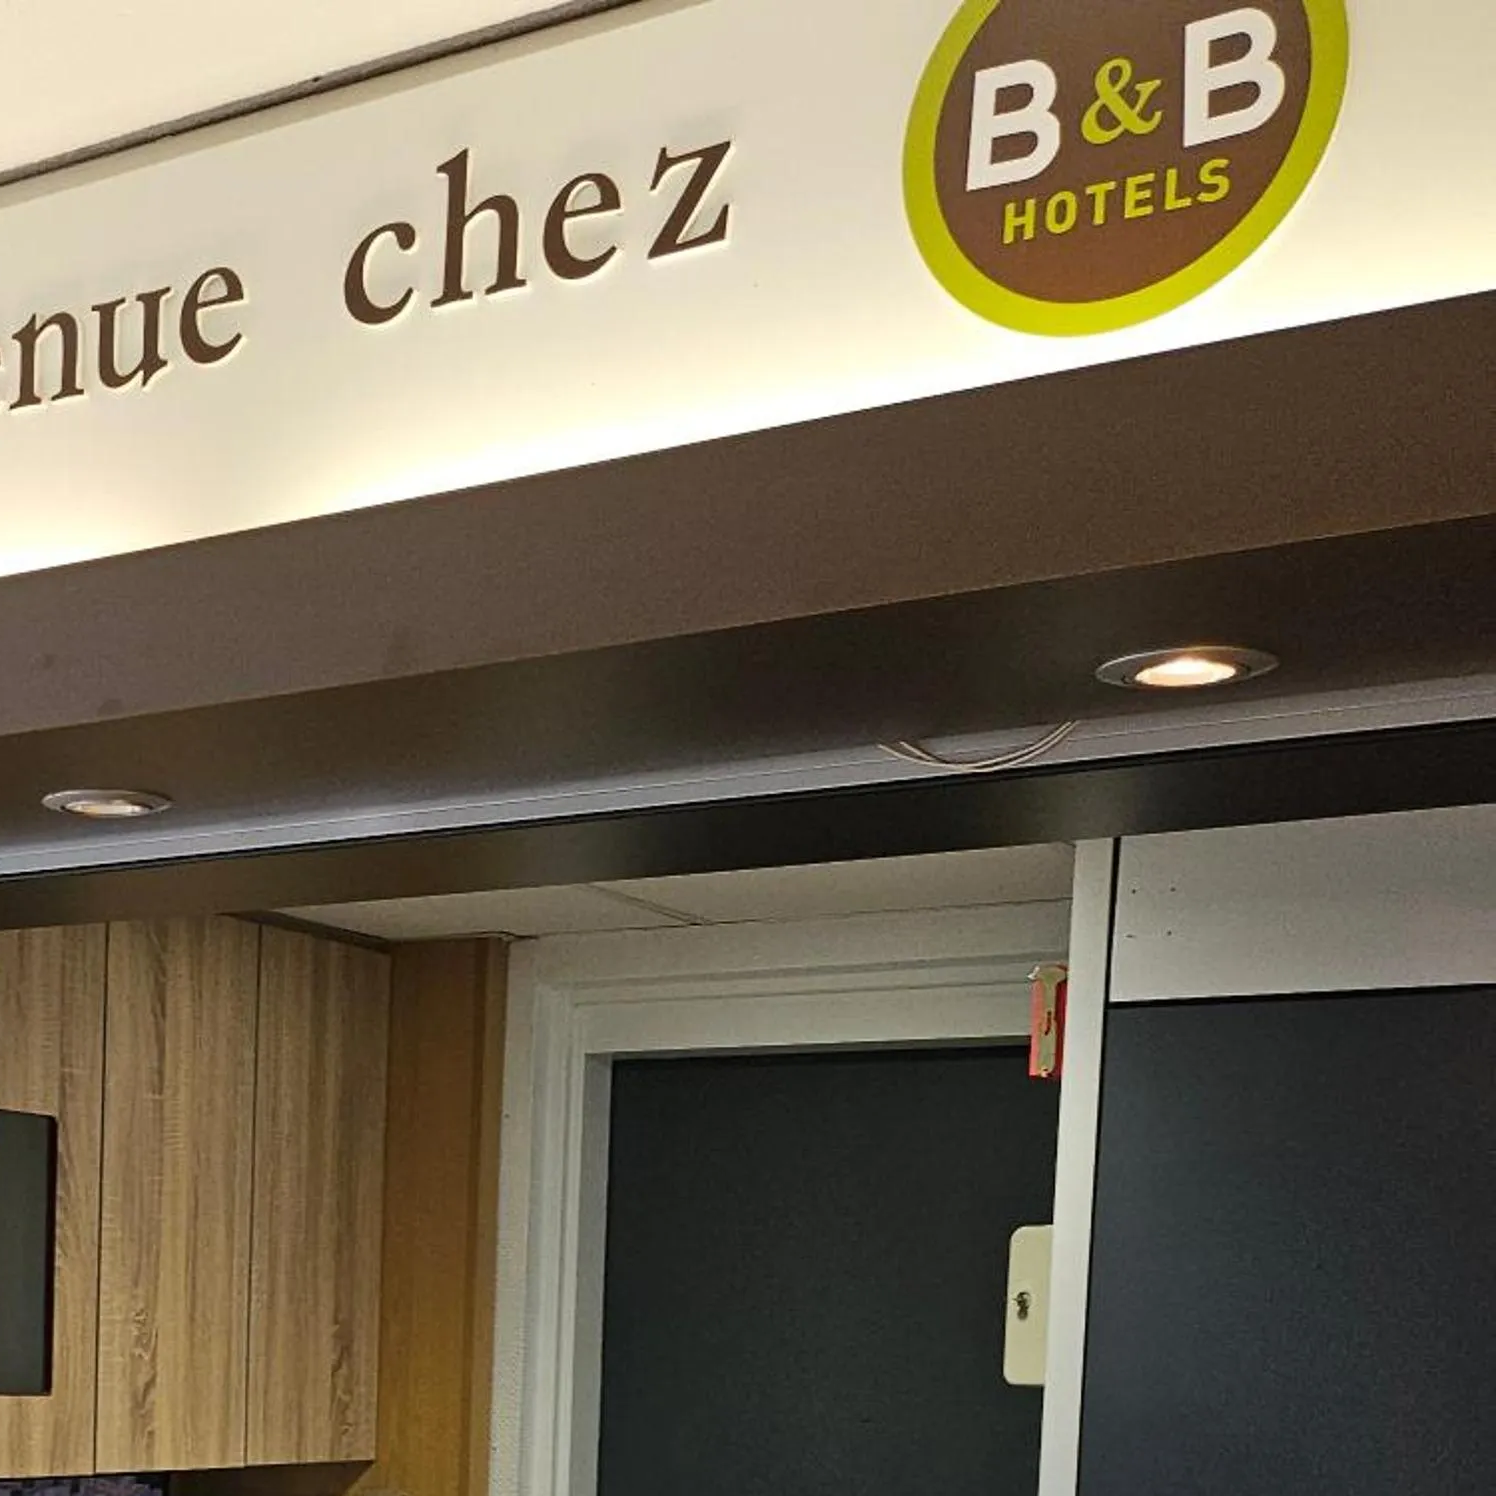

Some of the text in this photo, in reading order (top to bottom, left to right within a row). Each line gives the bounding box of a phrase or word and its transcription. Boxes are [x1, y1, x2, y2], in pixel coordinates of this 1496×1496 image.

[966, 7, 1285, 191] B&B
[344, 141, 730, 325] chez
[1003, 159, 1230, 244] HOTELS
